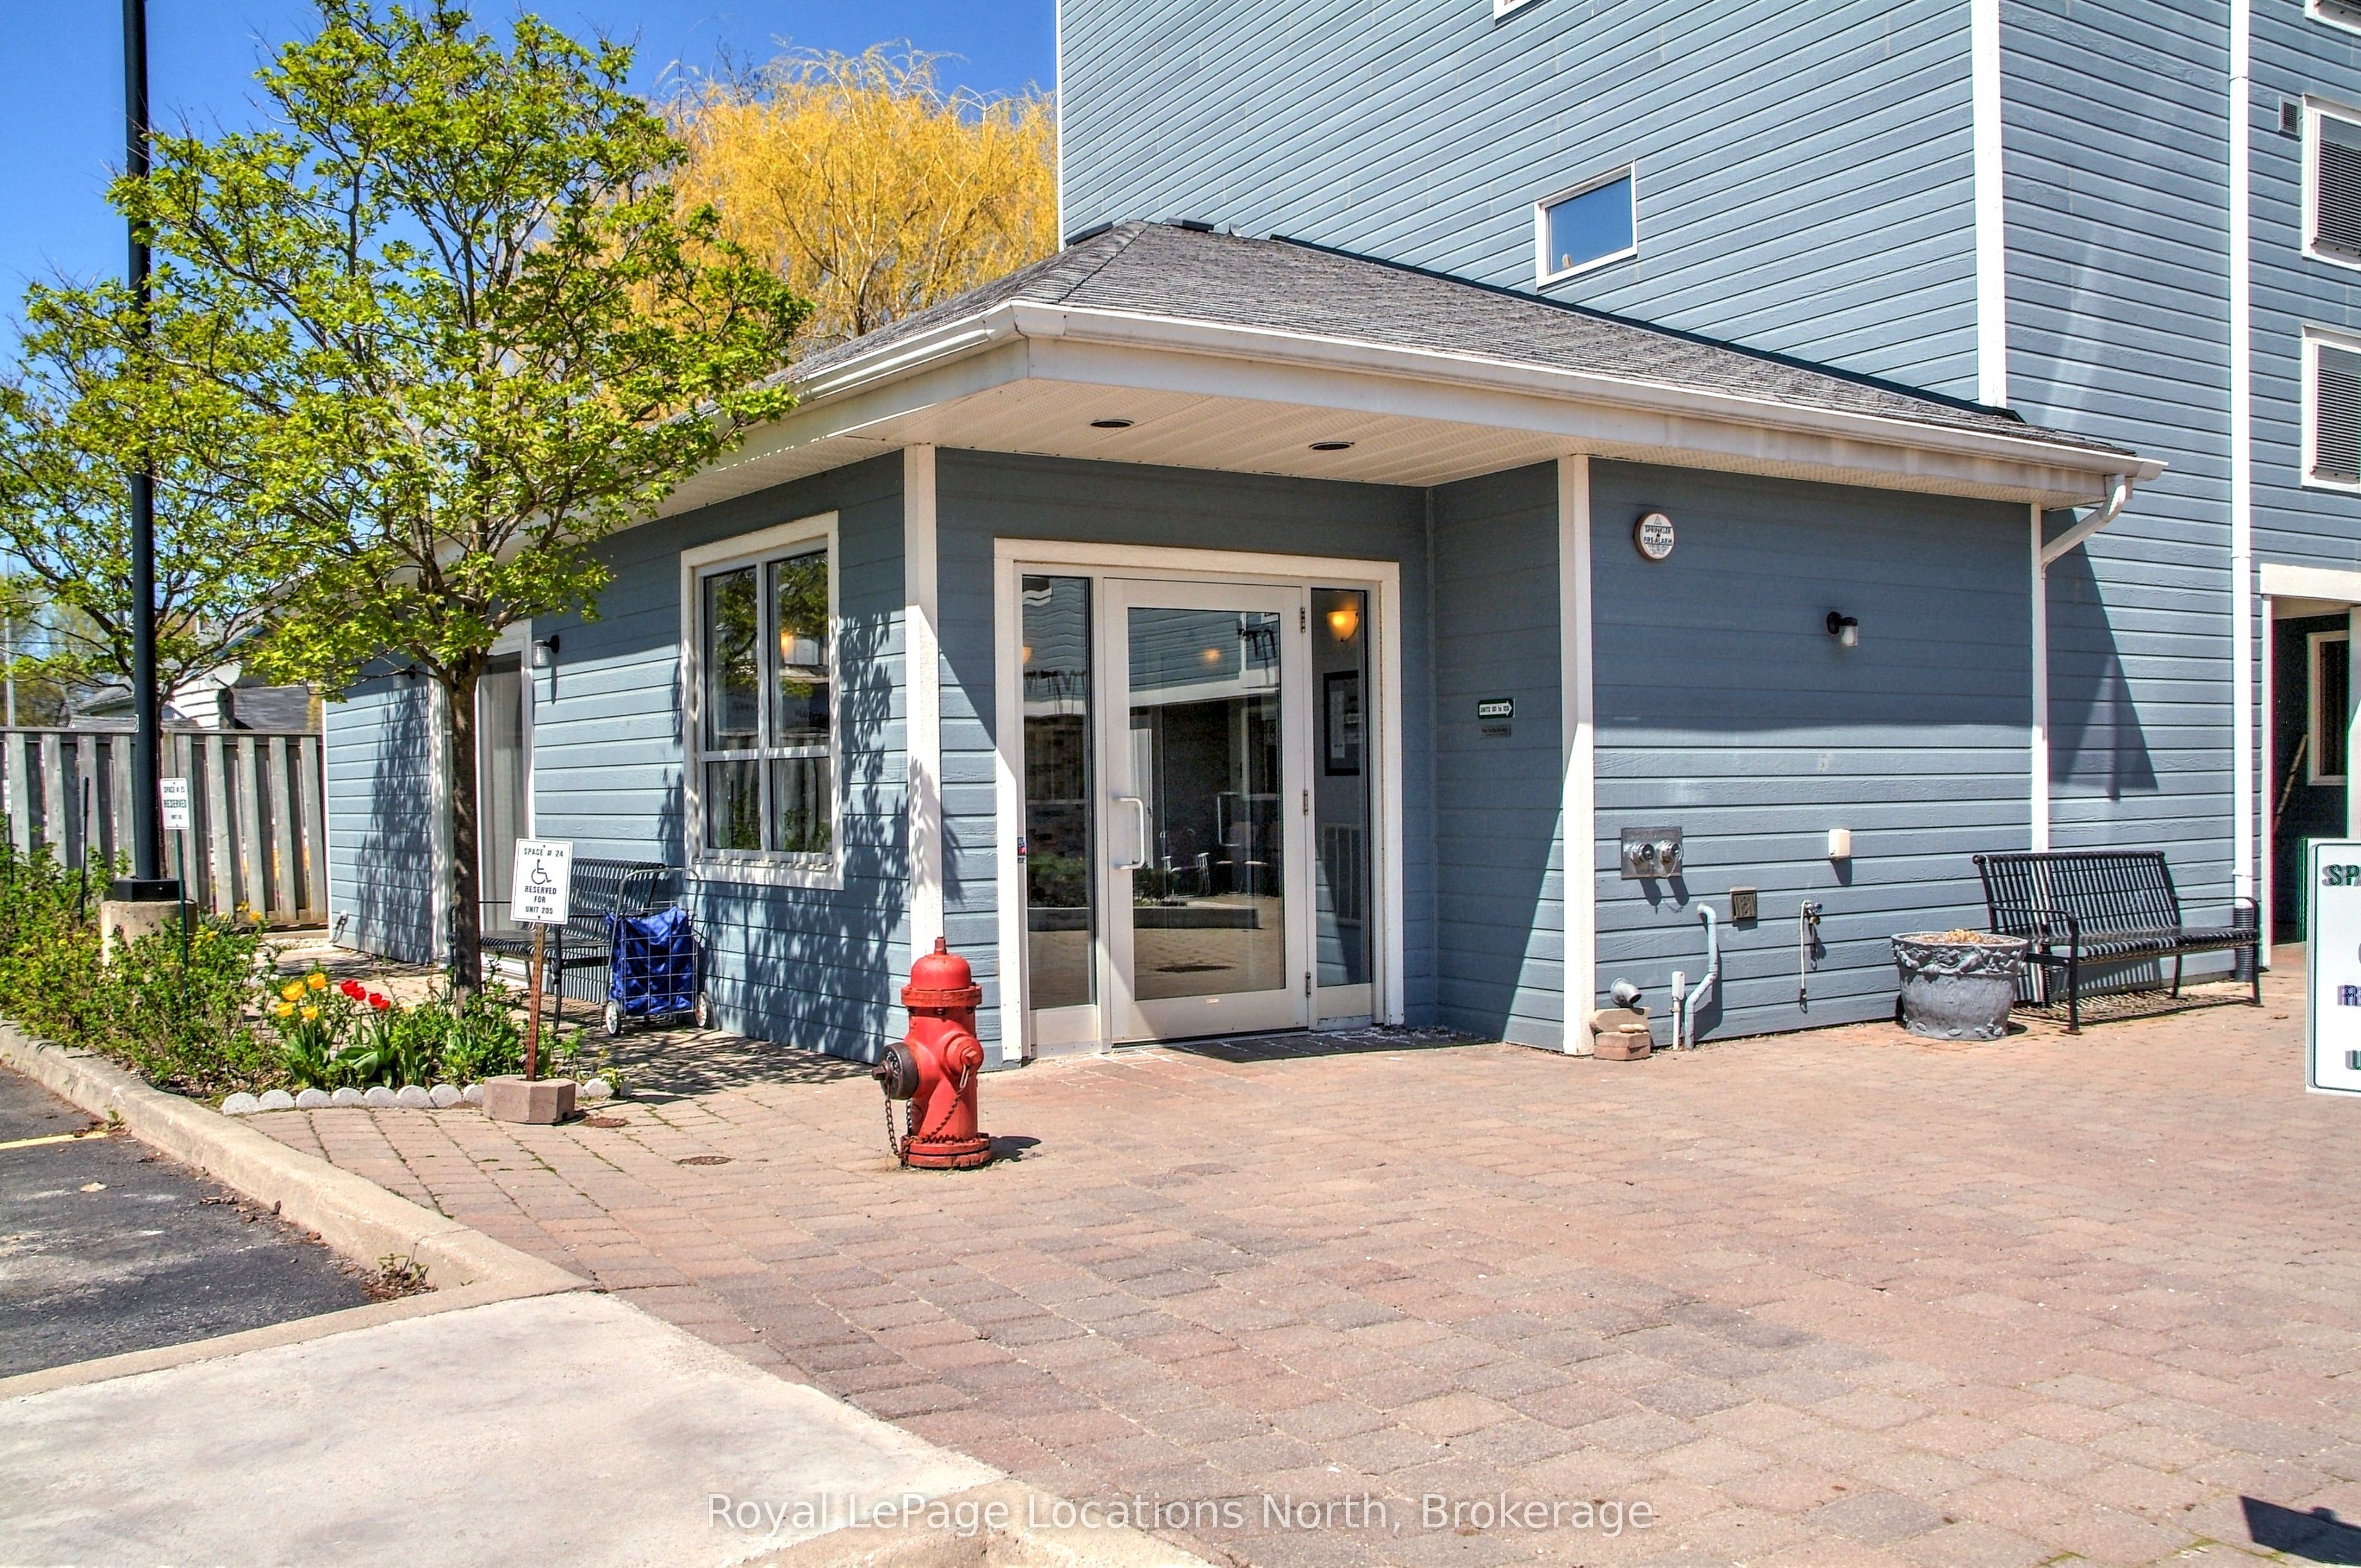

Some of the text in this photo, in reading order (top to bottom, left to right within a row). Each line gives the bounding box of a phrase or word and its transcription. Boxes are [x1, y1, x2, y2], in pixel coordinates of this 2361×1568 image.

[164, 799, 187, 808] RESERVED
[524, 847, 543, 857] SPACE
[524, 885, 557, 895] RESERVED
